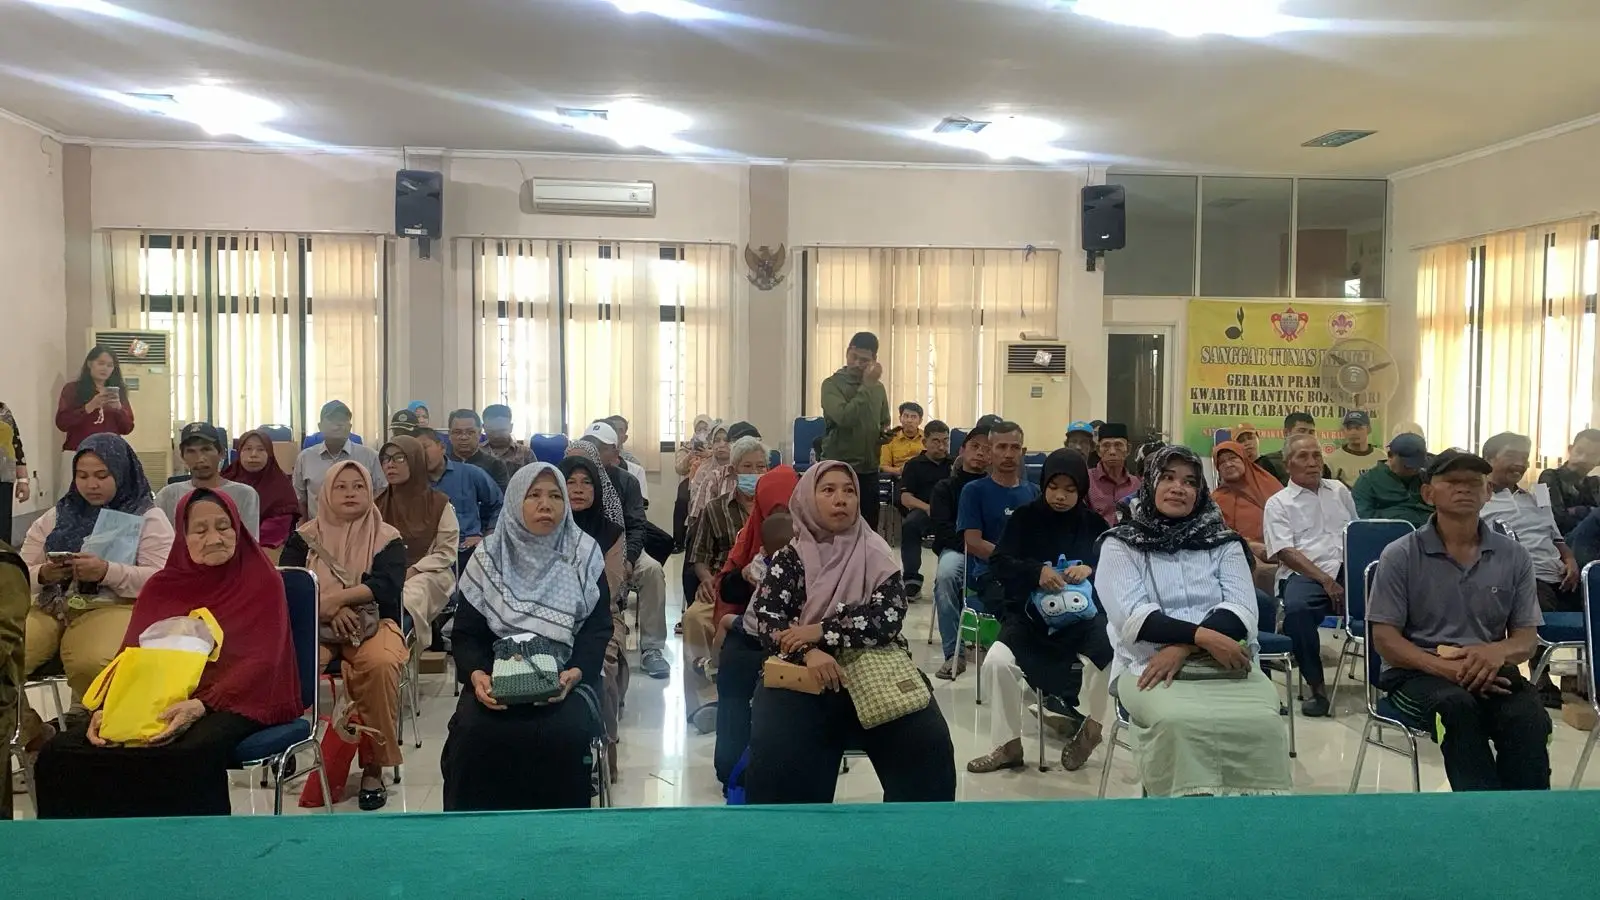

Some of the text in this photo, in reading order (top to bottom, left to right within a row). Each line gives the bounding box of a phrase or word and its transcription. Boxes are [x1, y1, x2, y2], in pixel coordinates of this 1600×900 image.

[1201, 346, 1267, 366] SANGGAR
[1269, 347, 1317, 367] TUNAS
[1227, 374, 1284, 388] GERAKAN
[1190, 387, 1246, 401] KWARTIR
[1251, 389, 1304, 402] RANTING
[1192, 402, 1249, 416] KWARTIR
[1253, 404, 1299, 417] CABANG
[1304, 405, 1334, 418] KOTA
